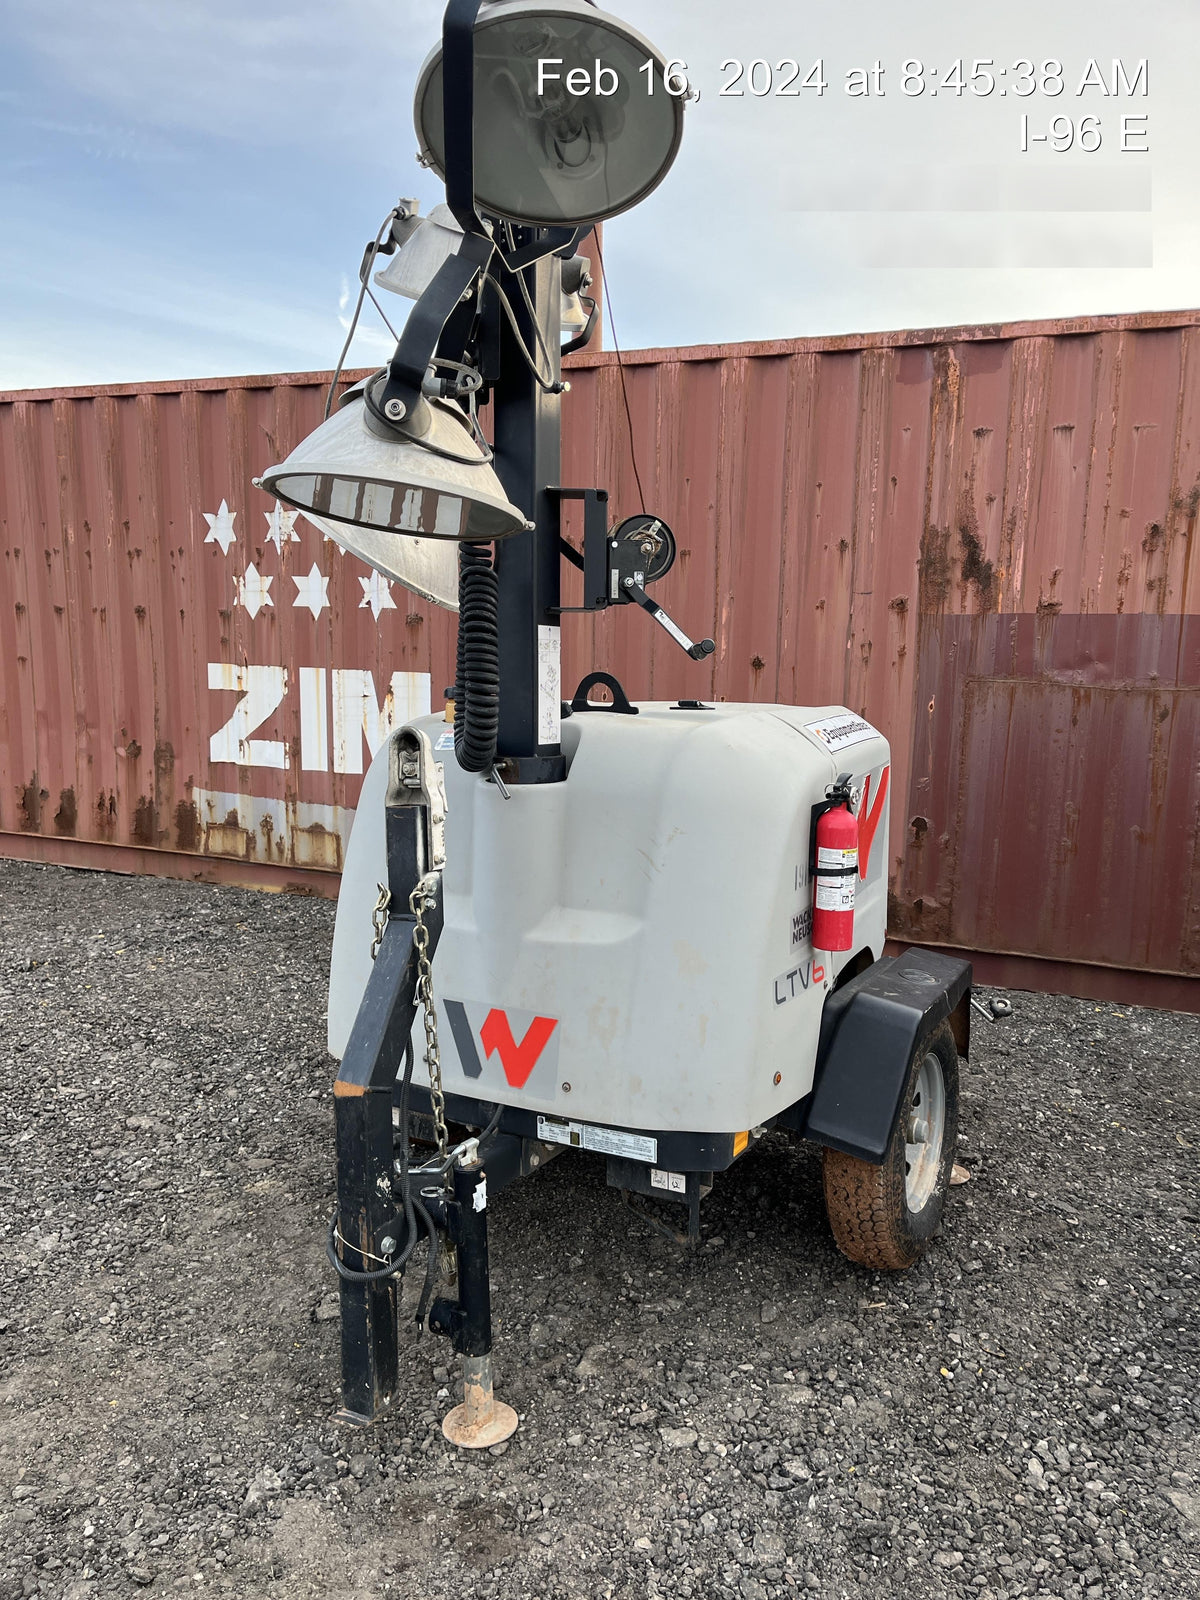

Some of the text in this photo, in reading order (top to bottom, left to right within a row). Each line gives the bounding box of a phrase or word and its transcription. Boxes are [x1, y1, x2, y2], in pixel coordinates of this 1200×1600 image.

[207, 663, 432, 775] ZIM
[792, 907, 812, 930] WACK
[792, 922, 812, 945] NEUS
[774, 959, 825, 1005] LTV6
